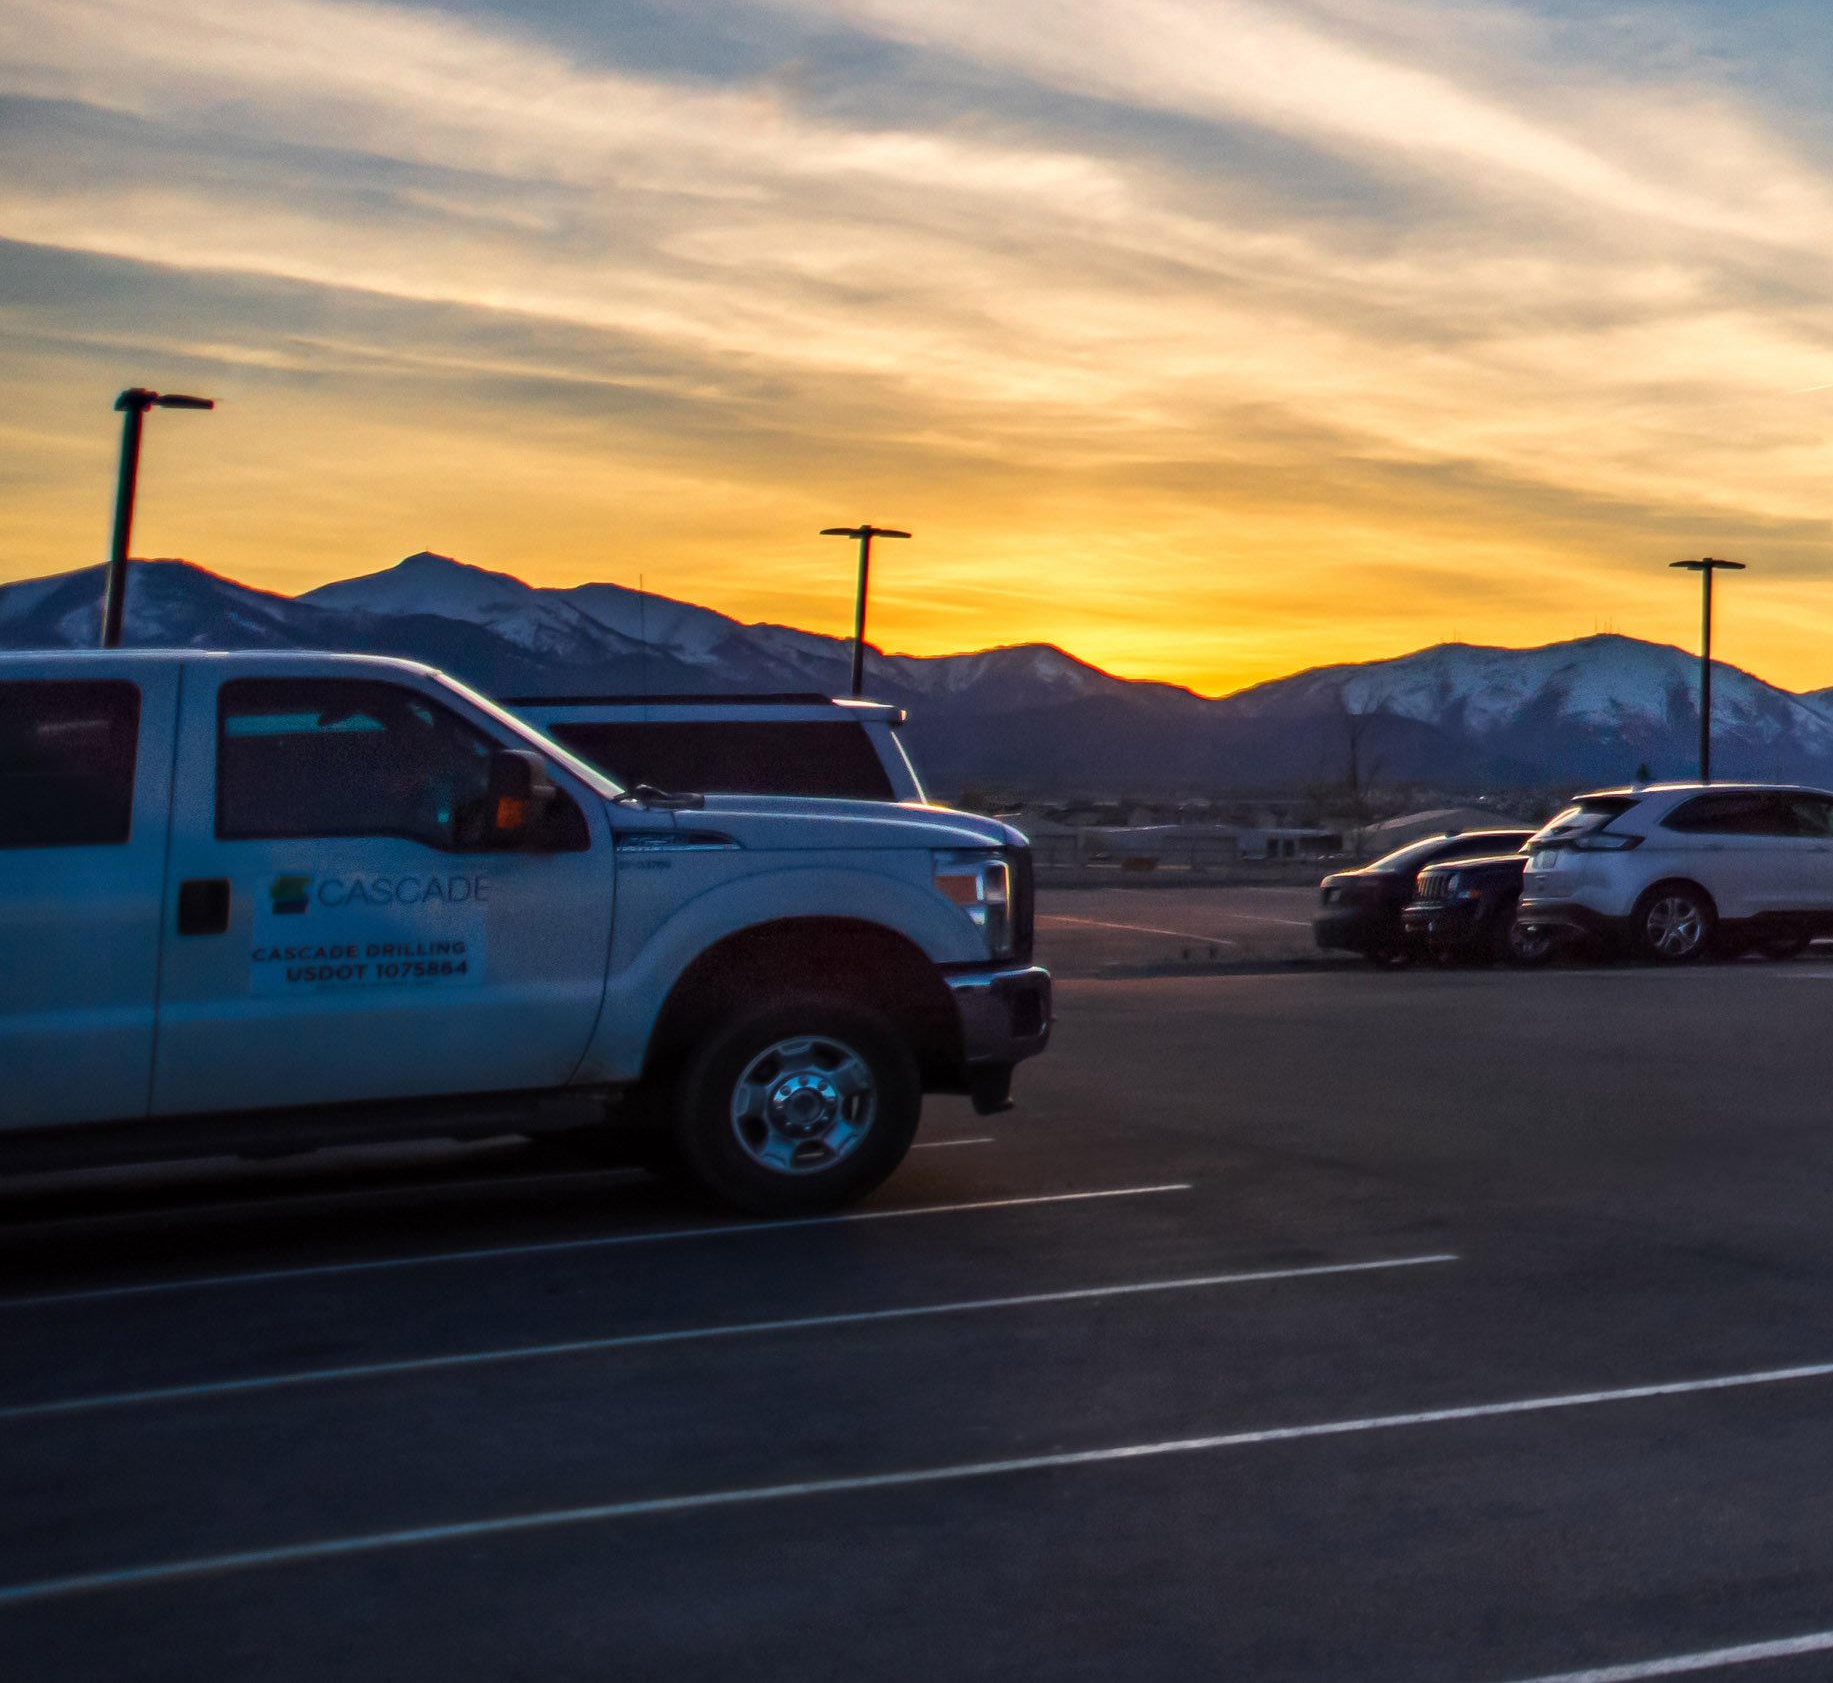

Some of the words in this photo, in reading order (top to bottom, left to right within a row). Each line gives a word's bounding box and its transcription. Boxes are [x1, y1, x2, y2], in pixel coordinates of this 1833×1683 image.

[317, 875, 489, 907] CASCADE
[251, 944, 358, 963] CASCADE
[366, 941, 466, 958] DRILLING
[286, 963, 367, 983] USDOT
